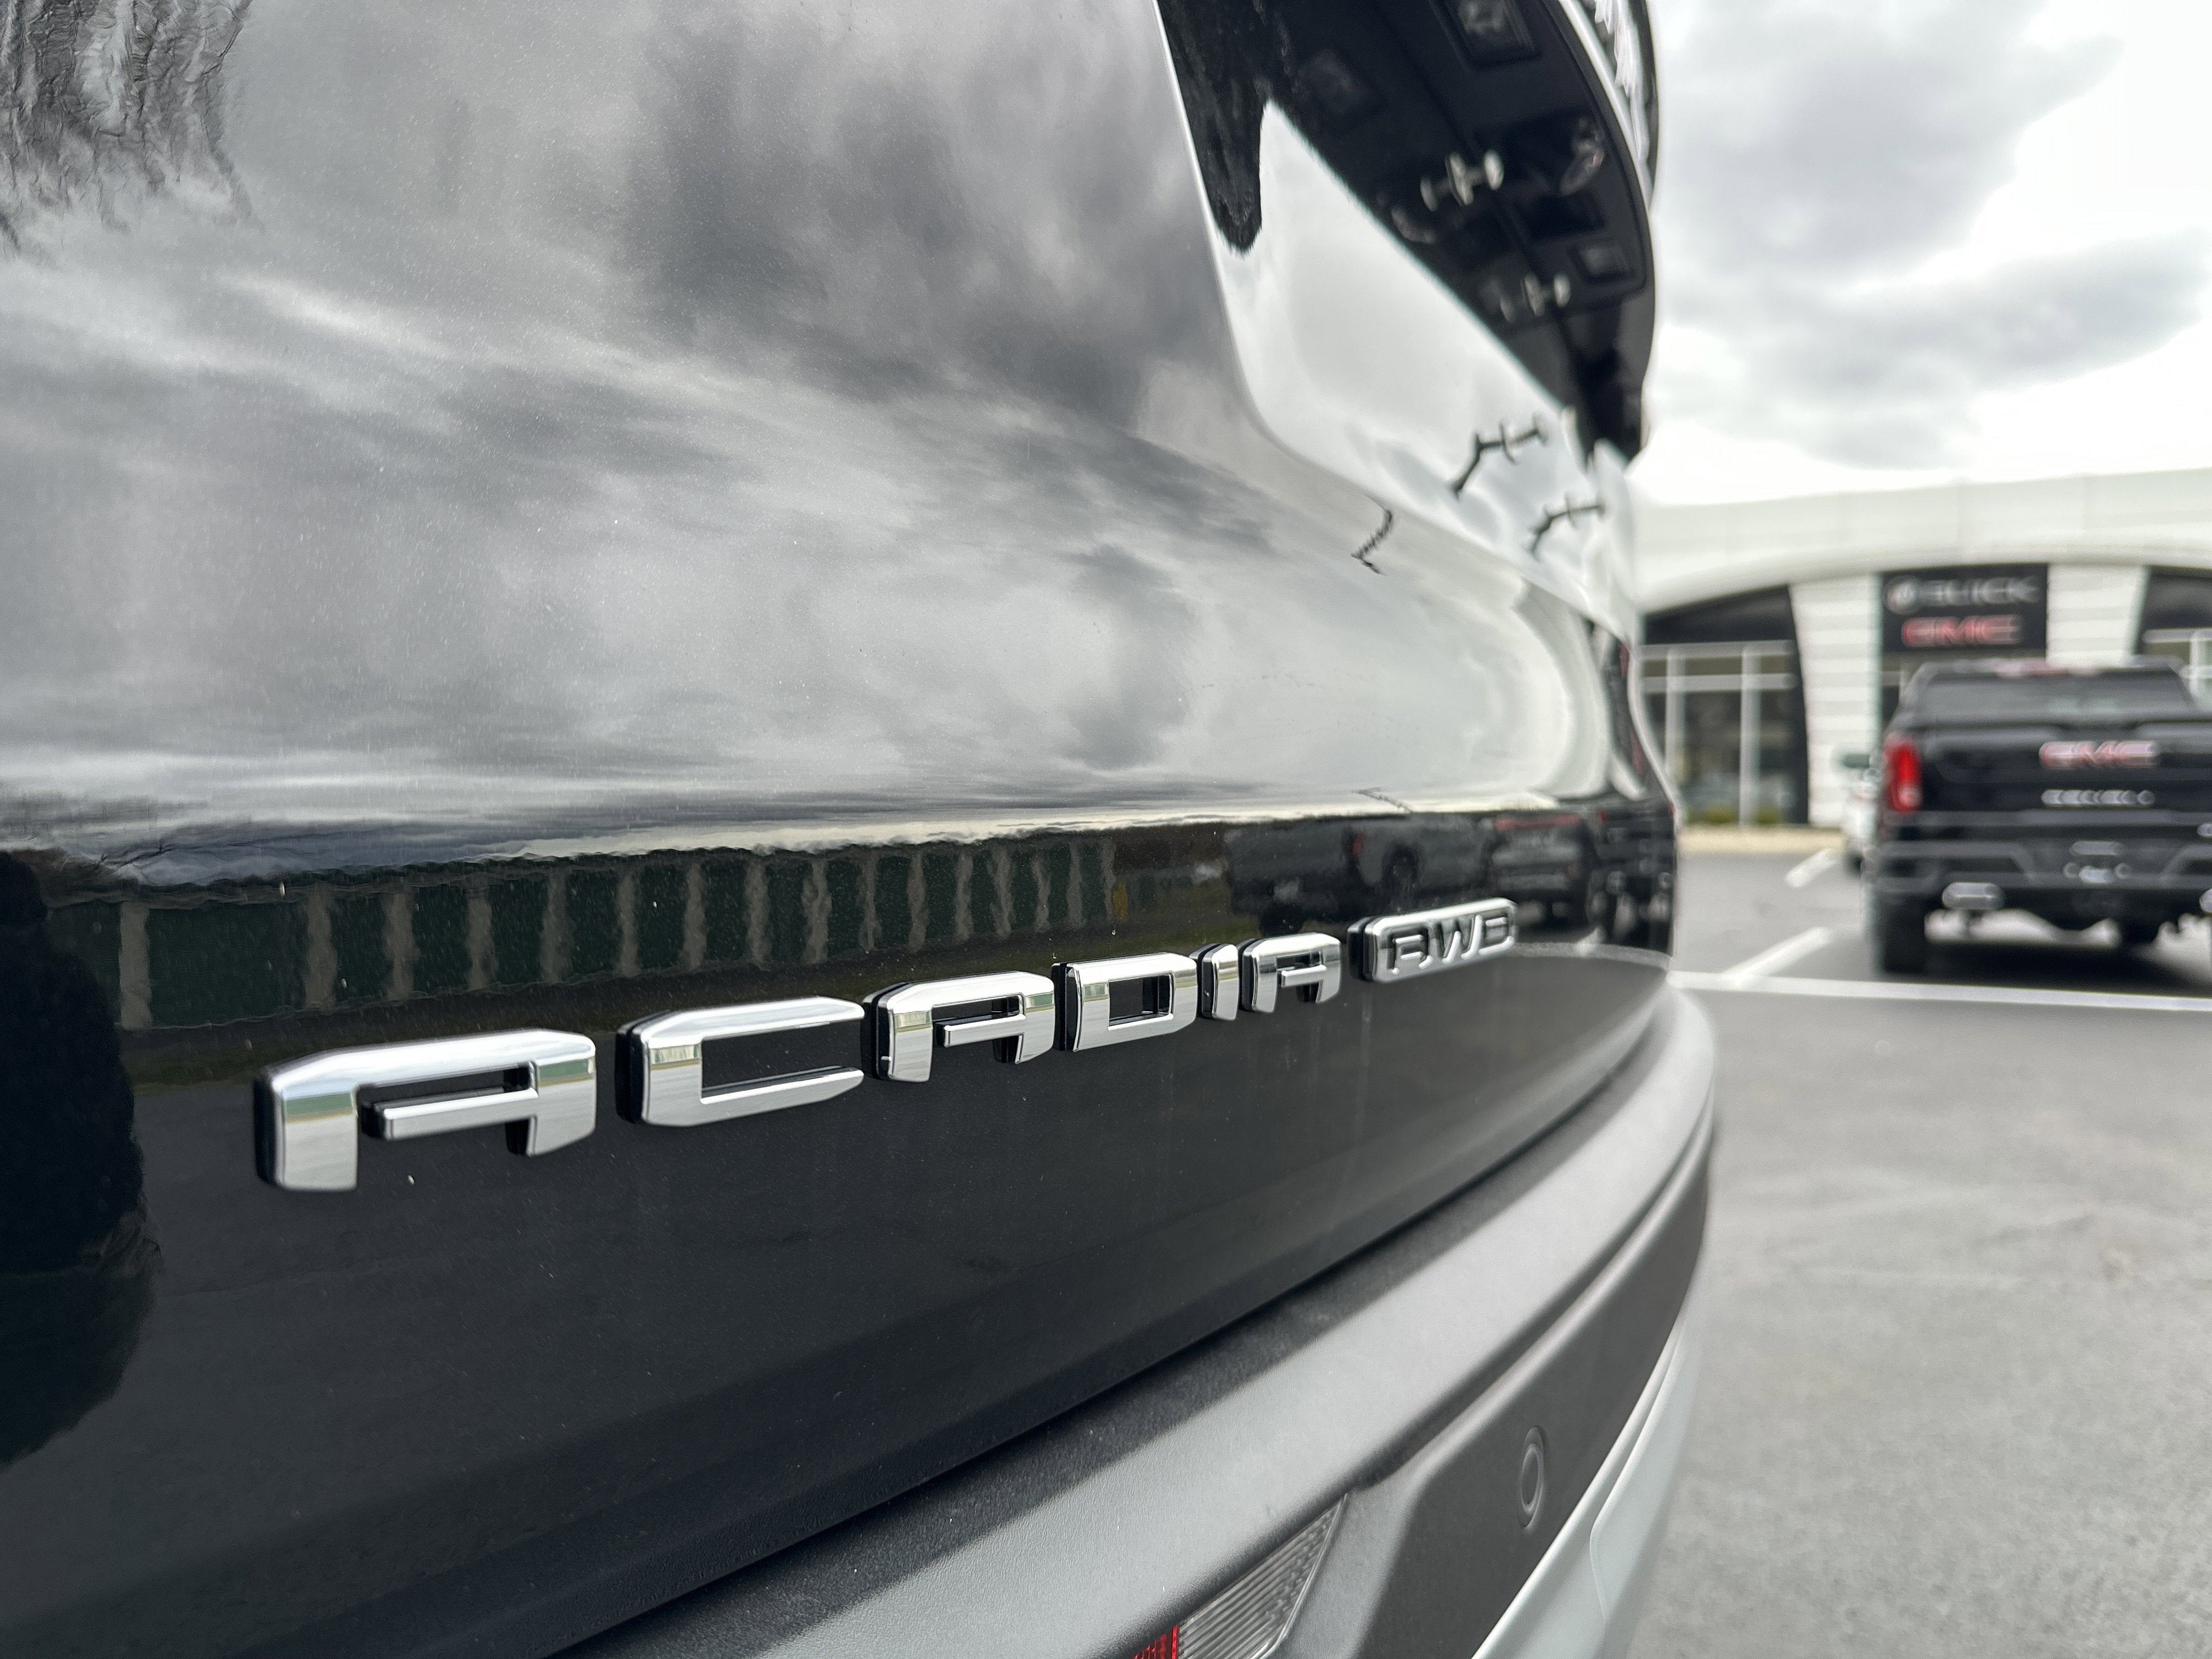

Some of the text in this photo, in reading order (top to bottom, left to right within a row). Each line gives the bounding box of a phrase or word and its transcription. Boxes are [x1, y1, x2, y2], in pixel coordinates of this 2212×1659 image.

[1901, 615, 2022, 647] GMC
[2039, 741, 2157, 768] GMC
[256, 912, 1516, 1192] ACADIA AWD
